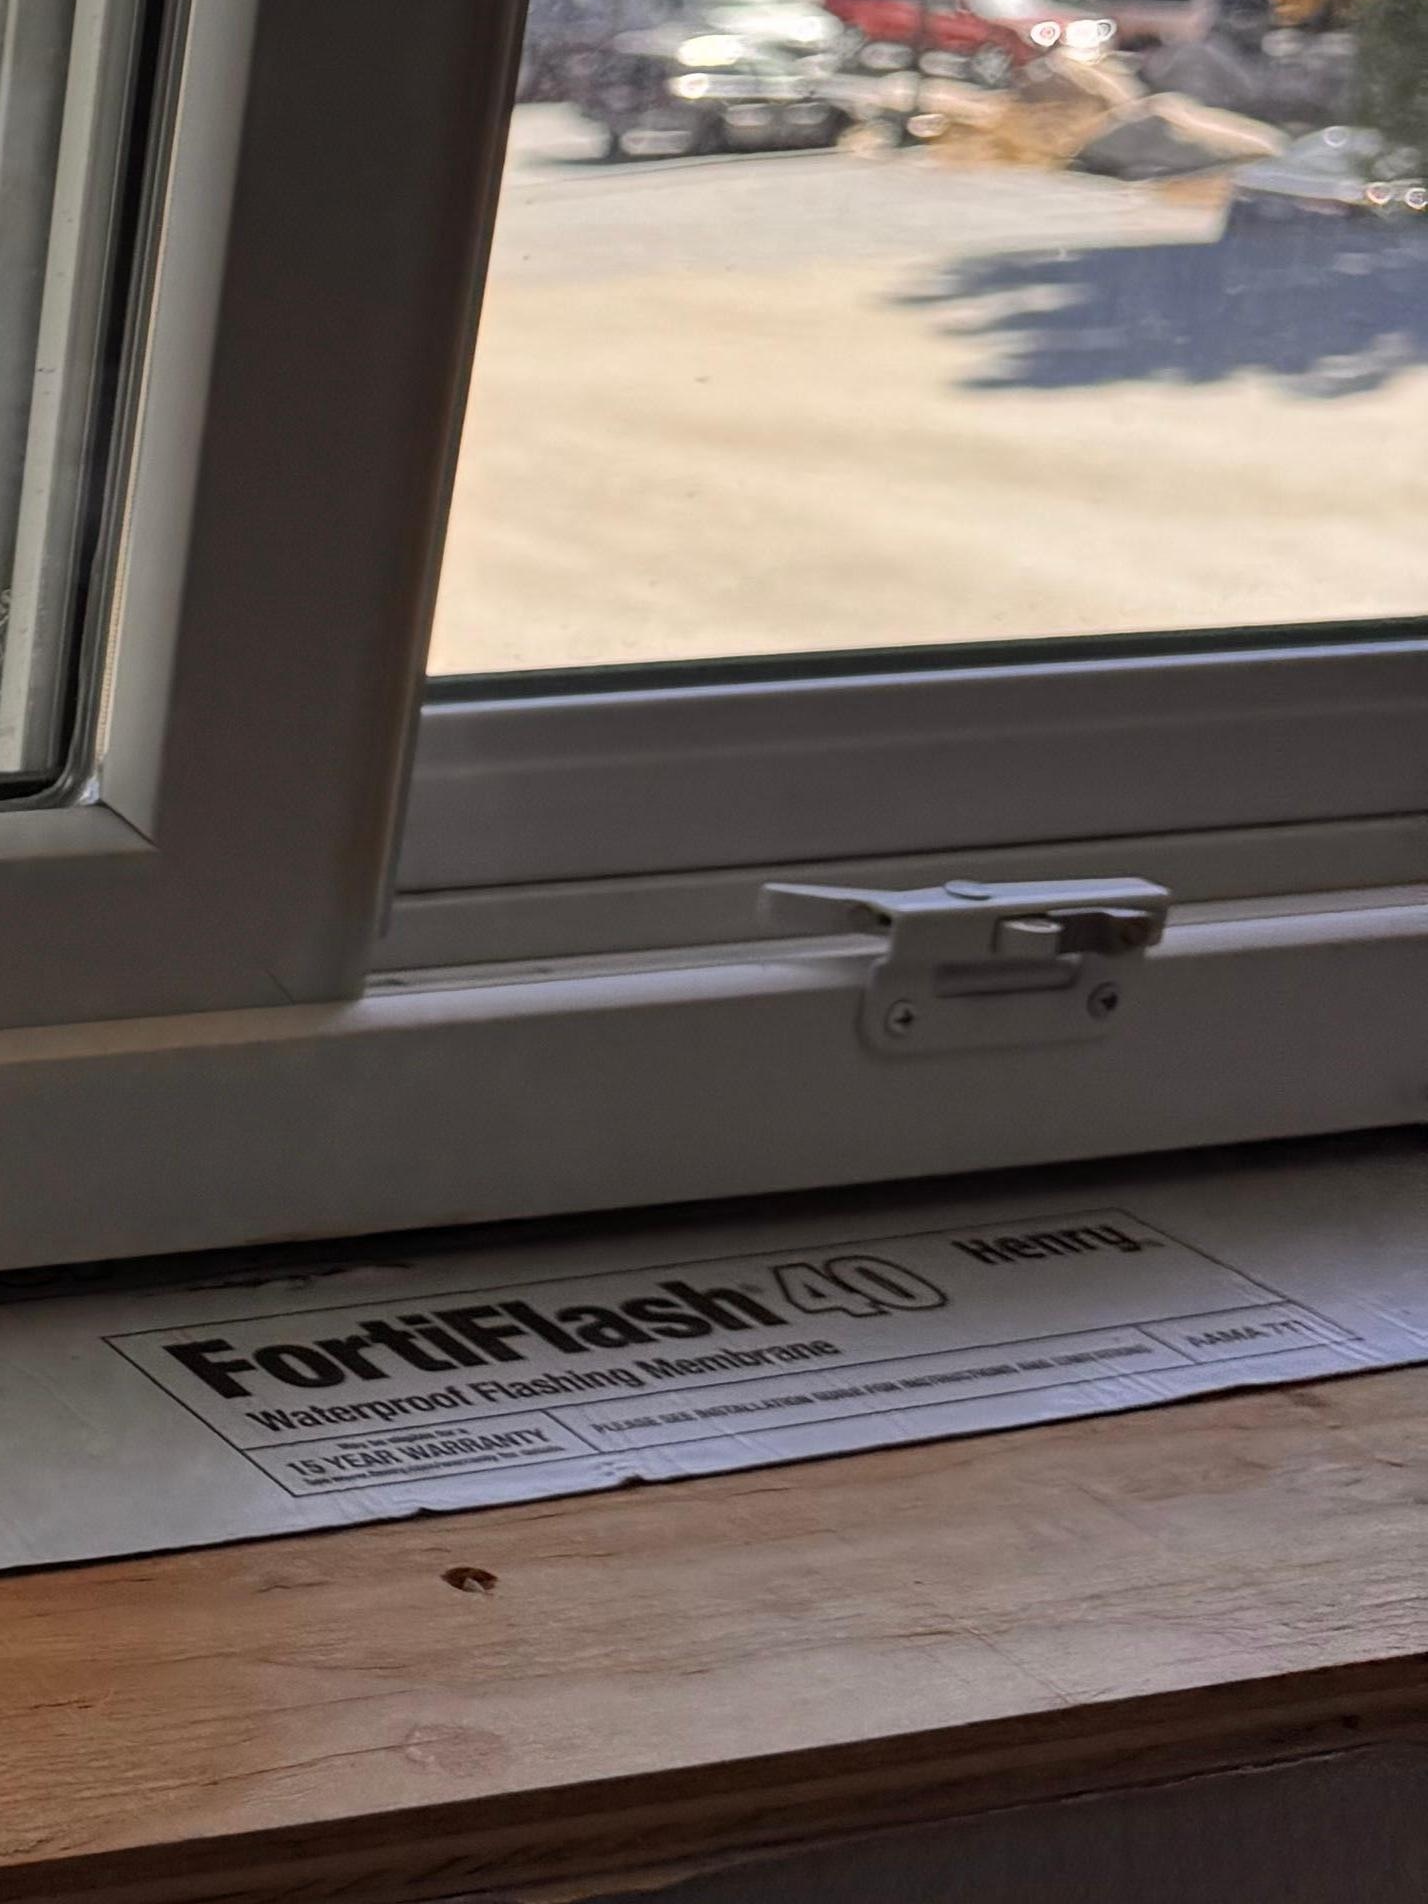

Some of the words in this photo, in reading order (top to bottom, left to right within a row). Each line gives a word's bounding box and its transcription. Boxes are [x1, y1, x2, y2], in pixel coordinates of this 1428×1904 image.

[768, 1254, 949, 1318] 40
[244, 1386, 471, 1433] Waterproof
[469, 1360, 643, 1402] Flashing
[636, 1338, 841, 1380] Membrane
[590, 1415, 661, 1434] PLEASE
[694, 1395, 814, 1418] INSTALLATION
[286, 1459, 326, 1476] 15
[322, 1449, 402, 1470] YEAR
[394, 1428, 551, 1461] WARRANTY
